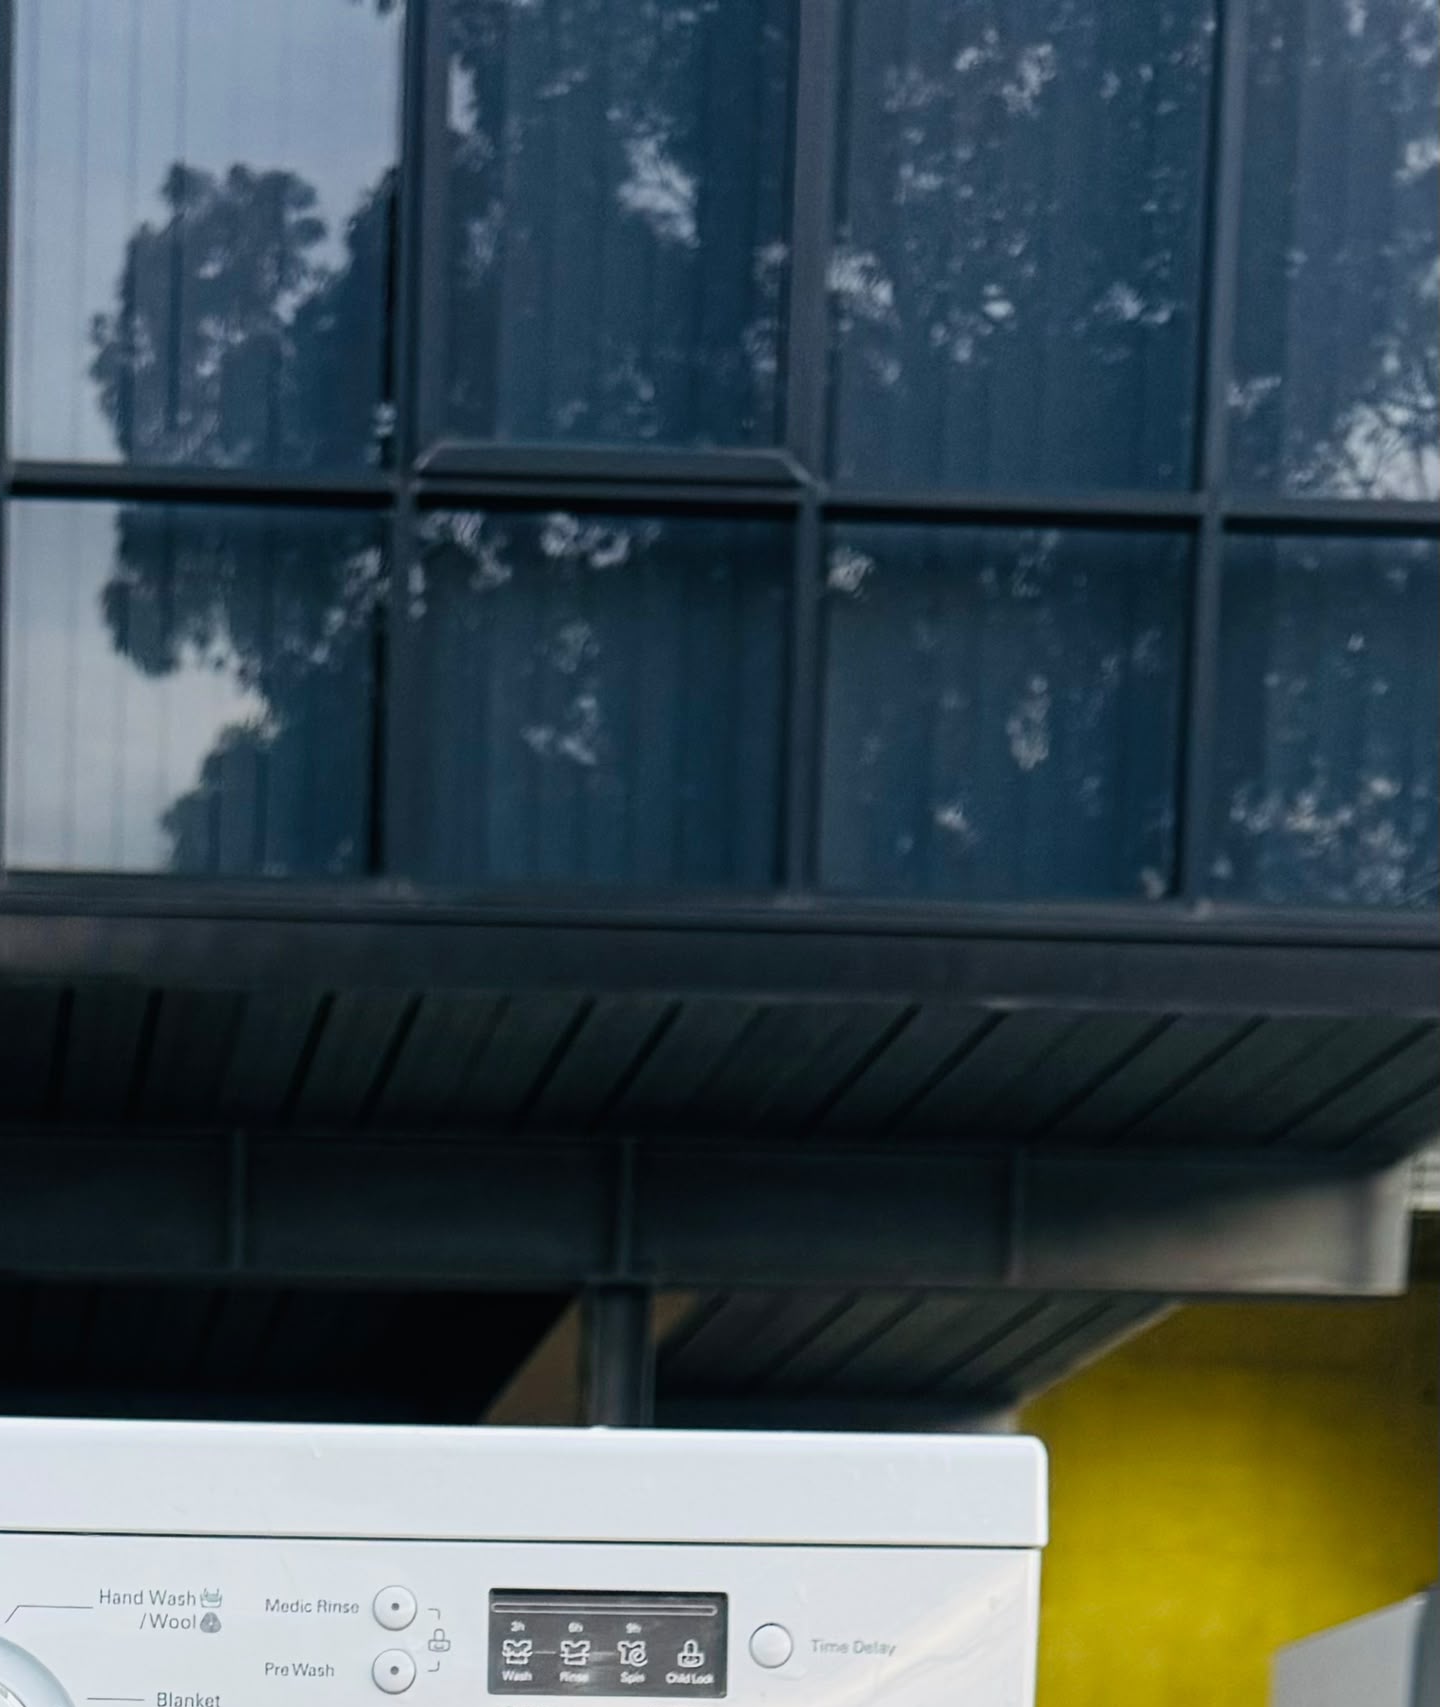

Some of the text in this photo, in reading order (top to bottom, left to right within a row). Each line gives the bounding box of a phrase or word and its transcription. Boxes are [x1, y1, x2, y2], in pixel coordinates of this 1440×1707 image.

[99, 1588, 196, 1607] Hand Wash
[265, 1598, 359, 1614] Medic Rinse
[811, 1639, 896, 1656] Time Delay
[265, 1662, 335, 1678] Pre Wash
[620, 1671, 645, 1684] Spin
